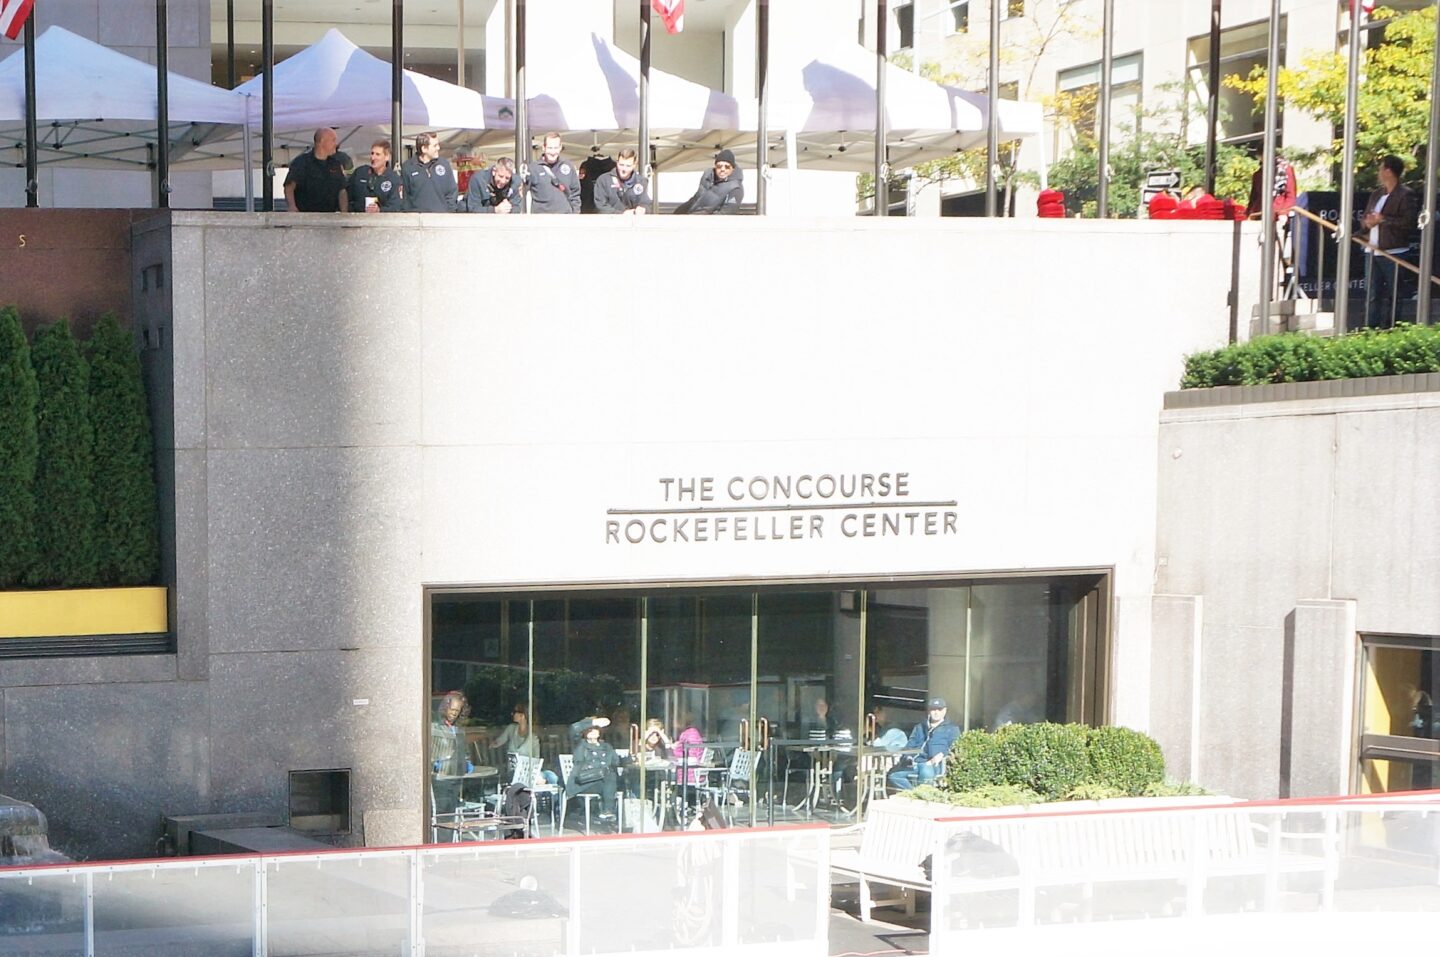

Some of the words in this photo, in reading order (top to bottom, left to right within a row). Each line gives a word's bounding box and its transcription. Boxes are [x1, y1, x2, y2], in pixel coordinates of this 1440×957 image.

[659, 477, 714, 501] THE
[727, 472, 910, 500] CONCOURSE
[606, 515, 825, 544] ROCKEFELLER
[840, 511, 958, 538] CENTER
